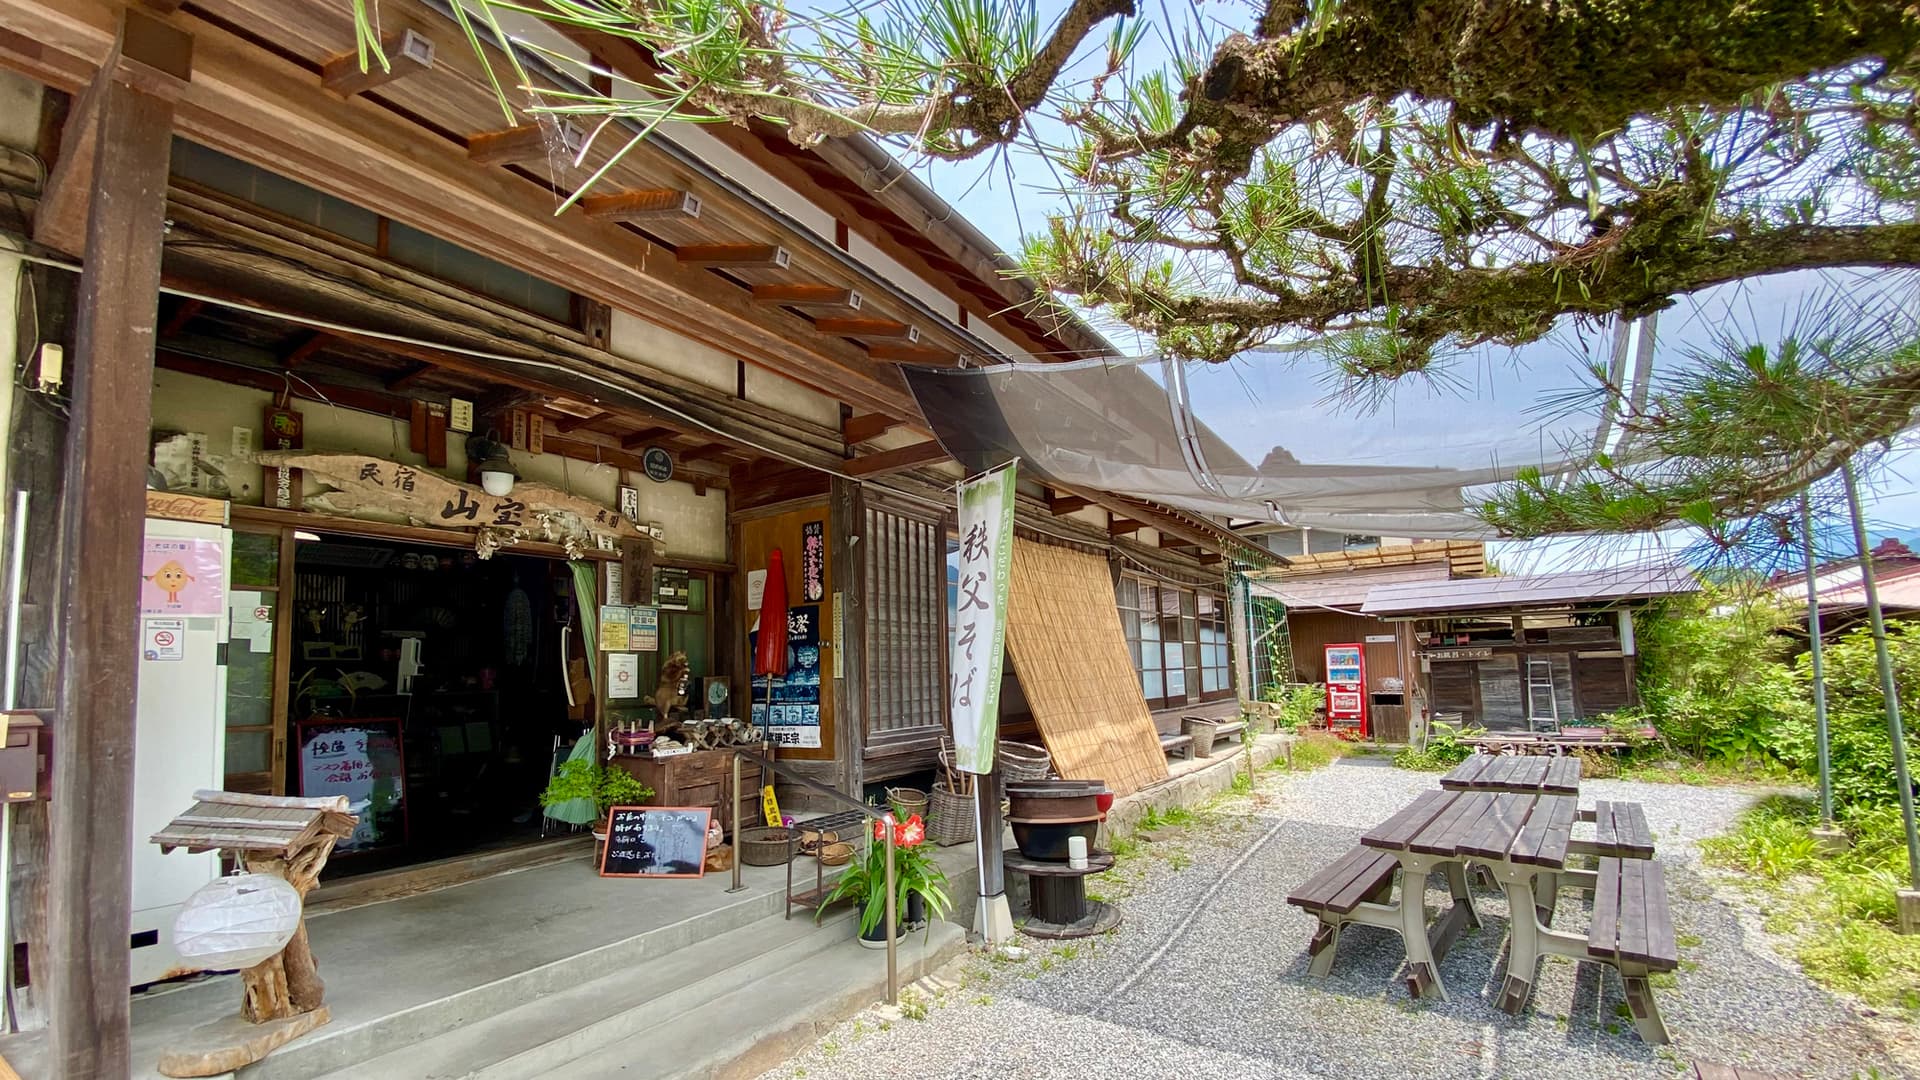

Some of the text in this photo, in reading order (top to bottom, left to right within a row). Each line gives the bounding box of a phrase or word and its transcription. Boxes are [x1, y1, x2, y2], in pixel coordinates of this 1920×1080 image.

[359, 463, 417, 492] 民宿
[441, 489, 526, 526] 山宝
[951, 519, 990, 709] 秩父そば
